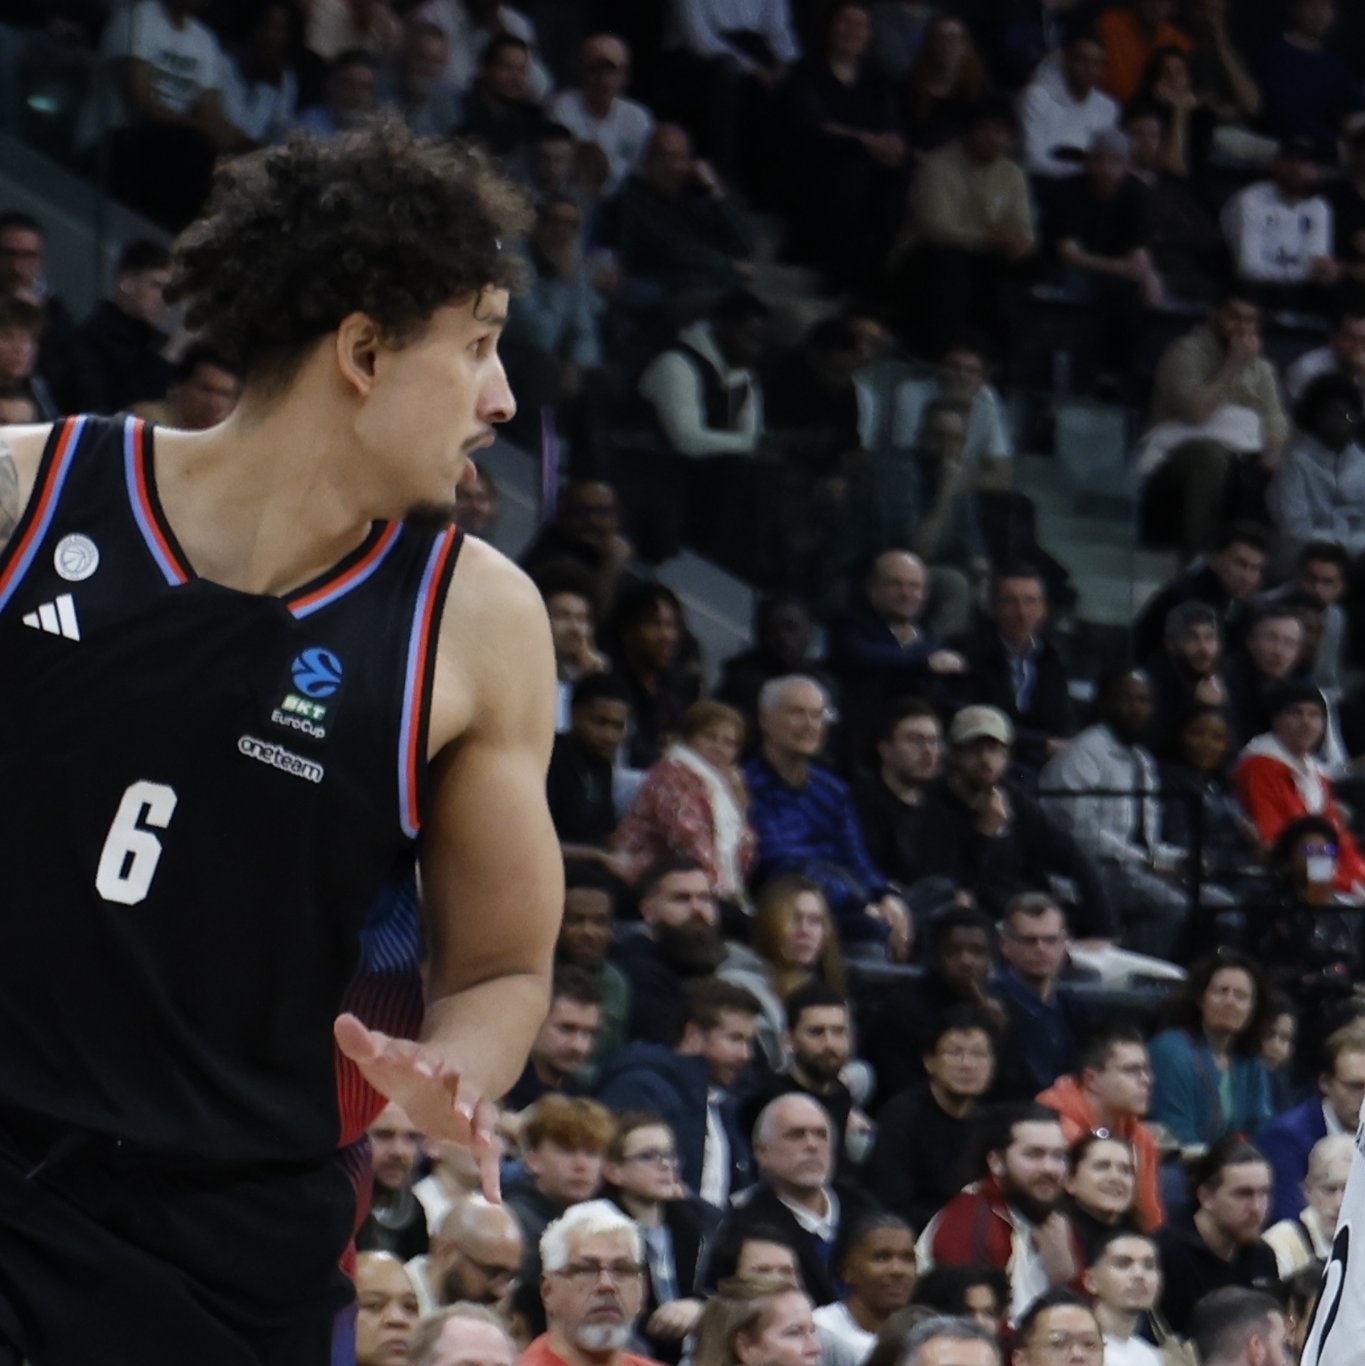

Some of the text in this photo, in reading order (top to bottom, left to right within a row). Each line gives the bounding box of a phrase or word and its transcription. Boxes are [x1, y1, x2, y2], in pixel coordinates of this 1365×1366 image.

[271, 709, 326, 738] EuroCup
[281, 695, 326, 720] BKT
[238, 735, 324, 783] oneteam
[96, 779, 178, 906] 6
